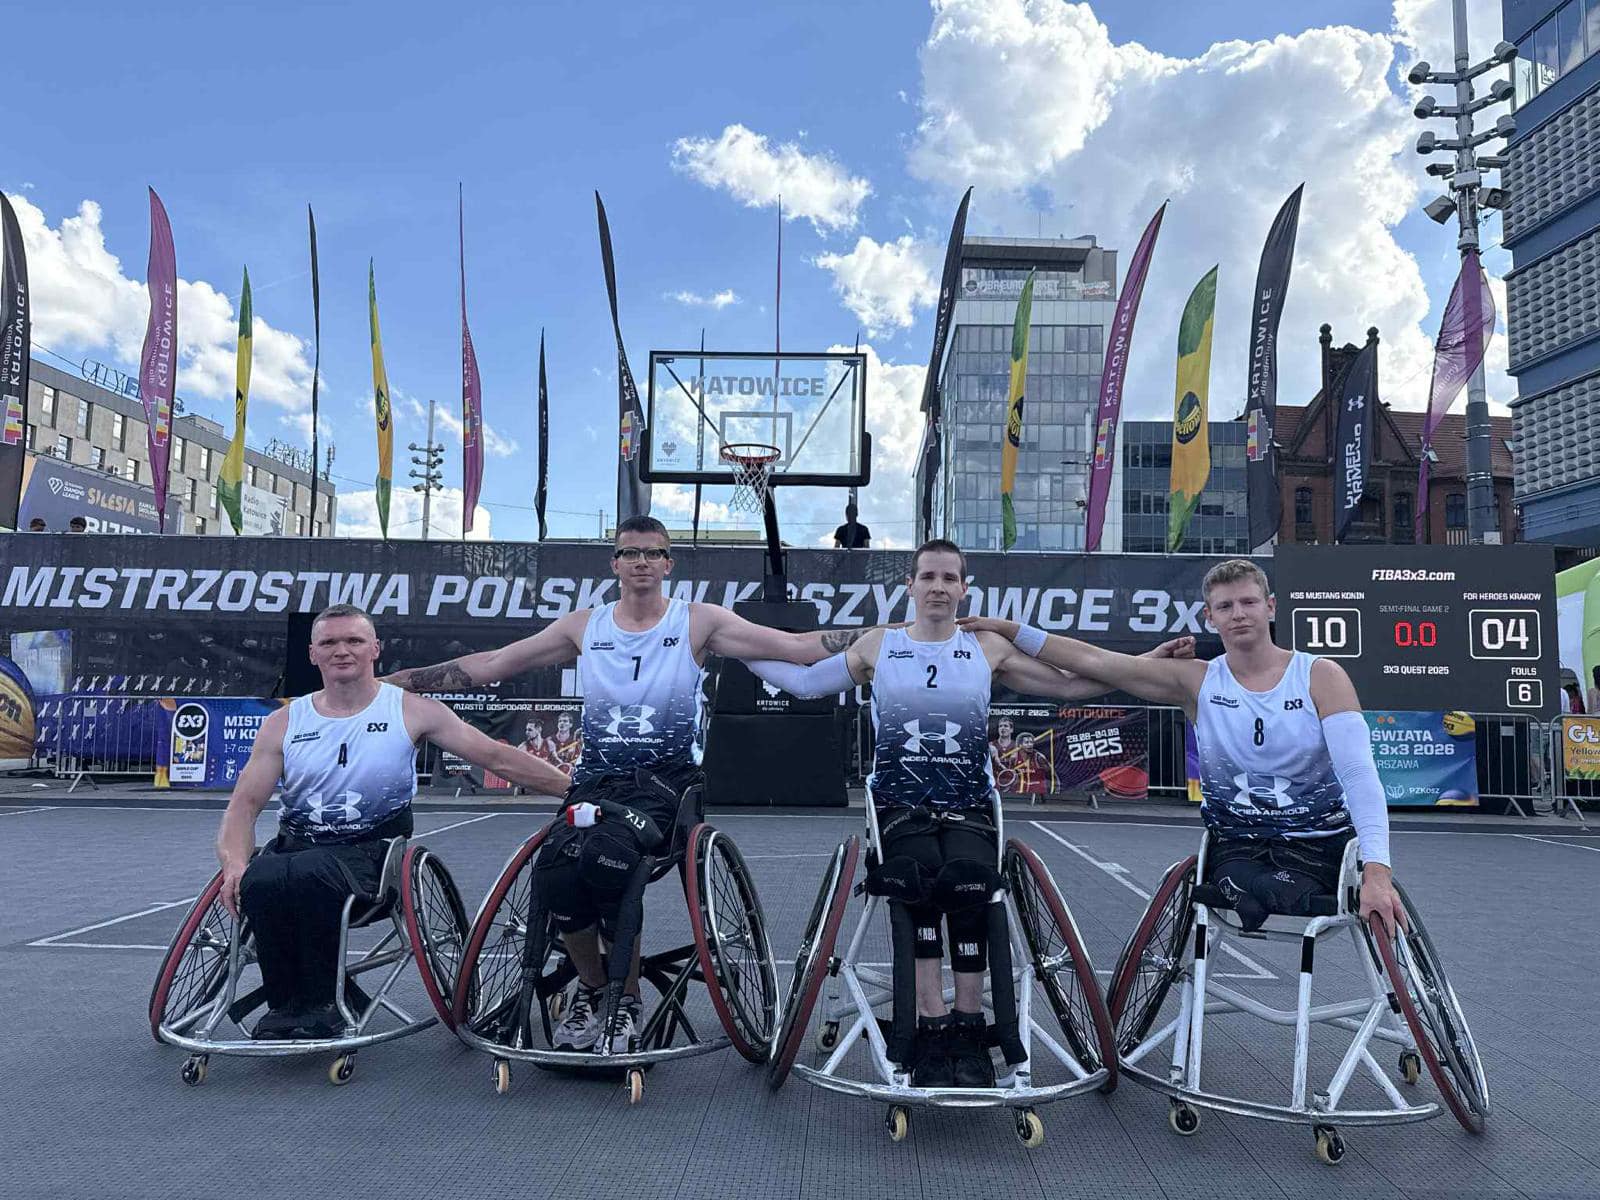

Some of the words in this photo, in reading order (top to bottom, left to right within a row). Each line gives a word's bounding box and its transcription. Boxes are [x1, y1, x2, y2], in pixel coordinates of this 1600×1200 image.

[1251, 287, 1272, 398] KATOWICE
[690, 376, 824, 396] KATOWICE
[87, 487, 135, 516] SILESIA
[1372, 569, 1455, 581] FIBA3x3.com
[2, 566, 409, 616] MISTRZOSTWA
[1290, 592, 1304, 600] KSS
[1306, 592, 1340, 600] MUSTANG
[1341, 592, 1365, 600] KONIN
[1509, 593, 1541, 601] KRAKOW
[1379, 605, 1420, 613] SEMI-FINAL
[1422, 605, 1443, 613] GAME
[1306, 617, 1347, 648] 10
[1394, 621, 1437, 647] 0.0
[1482, 618, 1529, 650] 04
[632, 656, 642, 681] 7
[1383, 665, 1399, 674] 3X3
[1400, 665, 1426, 674] QUEST
[1427, 666, 1450, 675] 2025
[1511, 667, 1537, 676] FOULS
[926, 664, 938, 689] 2
[1518, 683, 1532, 702] 6
[1028, 709, 1049, 717] 2025
[1059, 707, 1126, 719] KATOWICE
[223, 729, 237, 740] W
[1066, 728, 1119, 743] 28.08-04.09
[1254, 717, 1265, 746] 8
[1371, 727, 1433, 742] ŚWIATA
[1568, 724, 1600, 743] GŁ
[224, 743, 236, 753] 1-7
[338, 743, 348, 768] 4
[1068, 737, 1123, 761] 2025
[1380, 744, 1409, 755] 3x3
[1413, 744, 1455, 756] 2026
[930, 757, 972, 765] ARMOUR
[1262, 807, 1309, 816] ARMOUR
[923, 927, 937, 941] NBA
[964, 942, 979, 956] NBA
